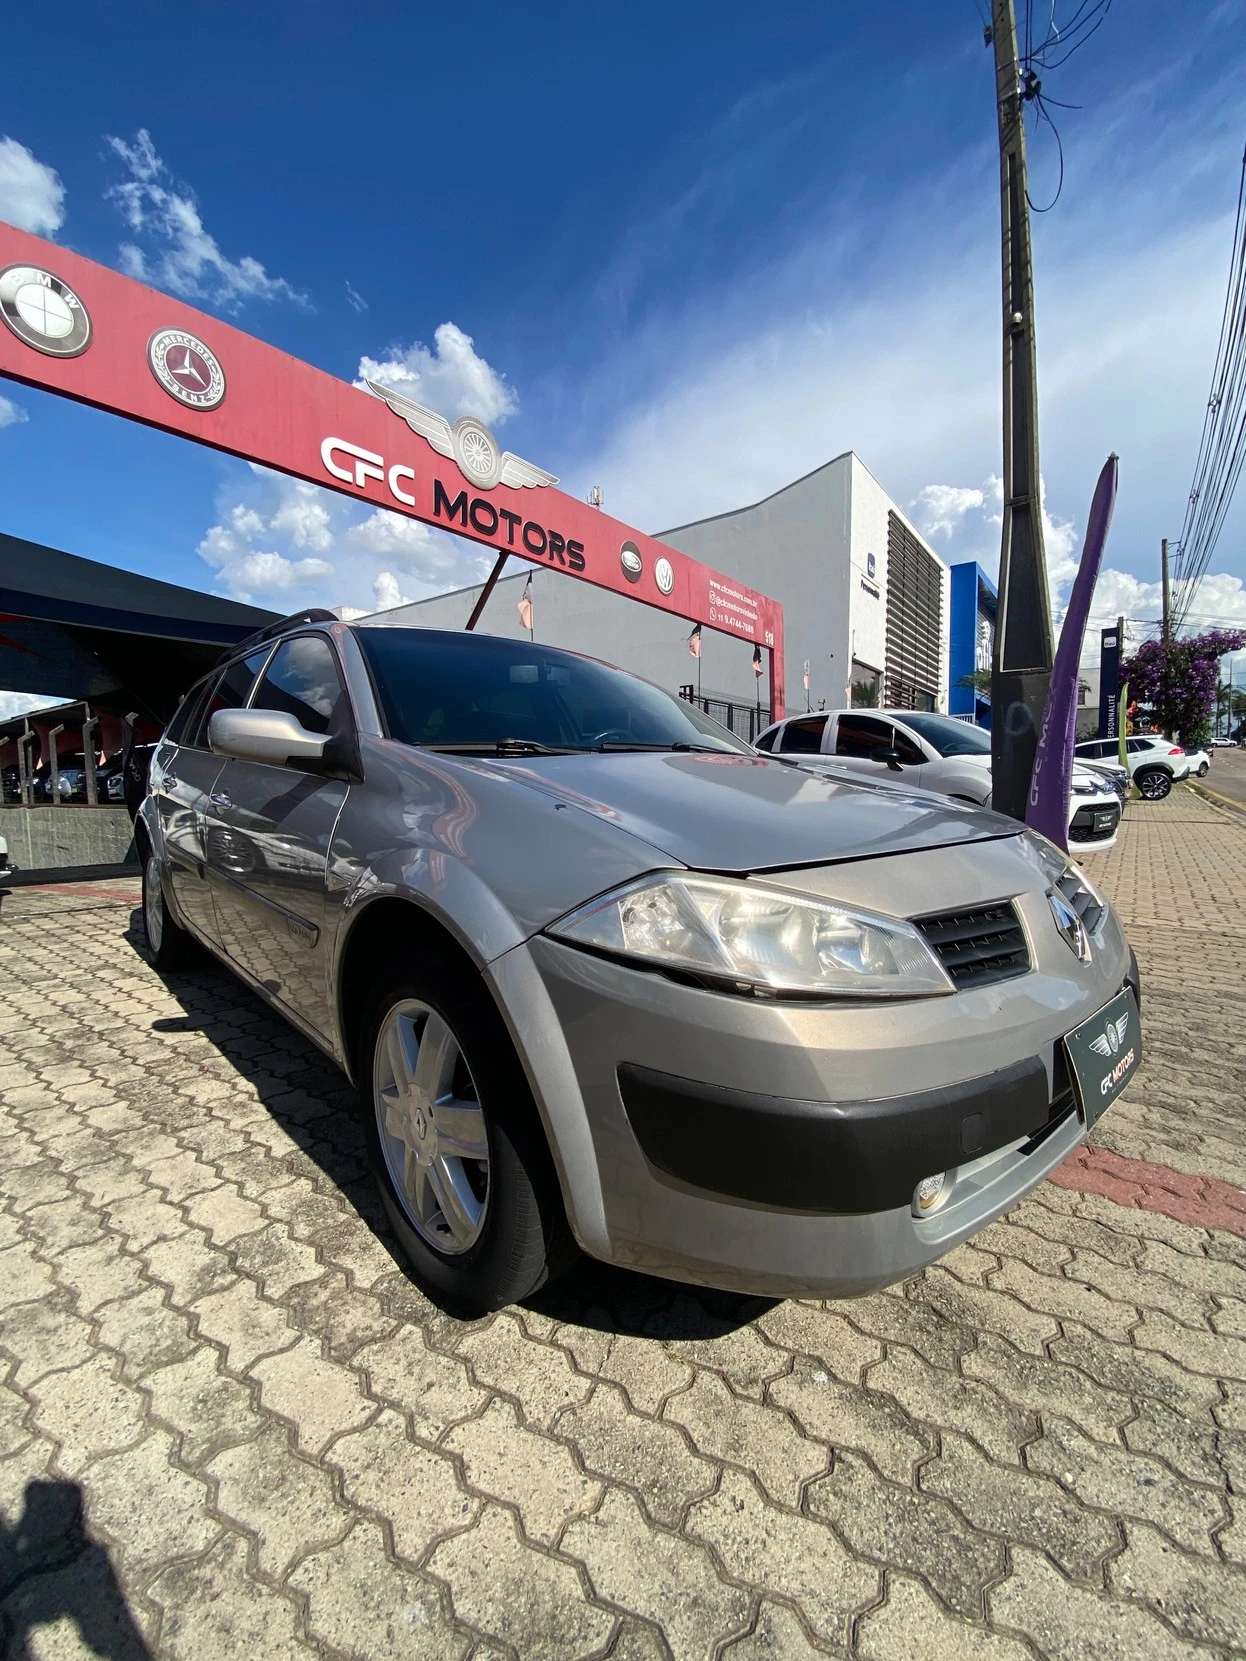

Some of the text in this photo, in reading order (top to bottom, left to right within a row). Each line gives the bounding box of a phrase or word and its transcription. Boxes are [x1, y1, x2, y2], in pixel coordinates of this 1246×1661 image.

[162, 335, 215, 366] MERCEDES
[172, 383, 207, 403] BENZ
[320, 436, 586, 572] CFC MOTORS
[709, 579, 758, 607] www.cfcmotors.com.br
[1107, 694, 1116, 738] ERSONNALITÉ
[1030, 757, 1043, 807] CFC
[1100, 1073, 1113, 1095] CFC
[1112, 1048, 1135, 1083] MOTORS
